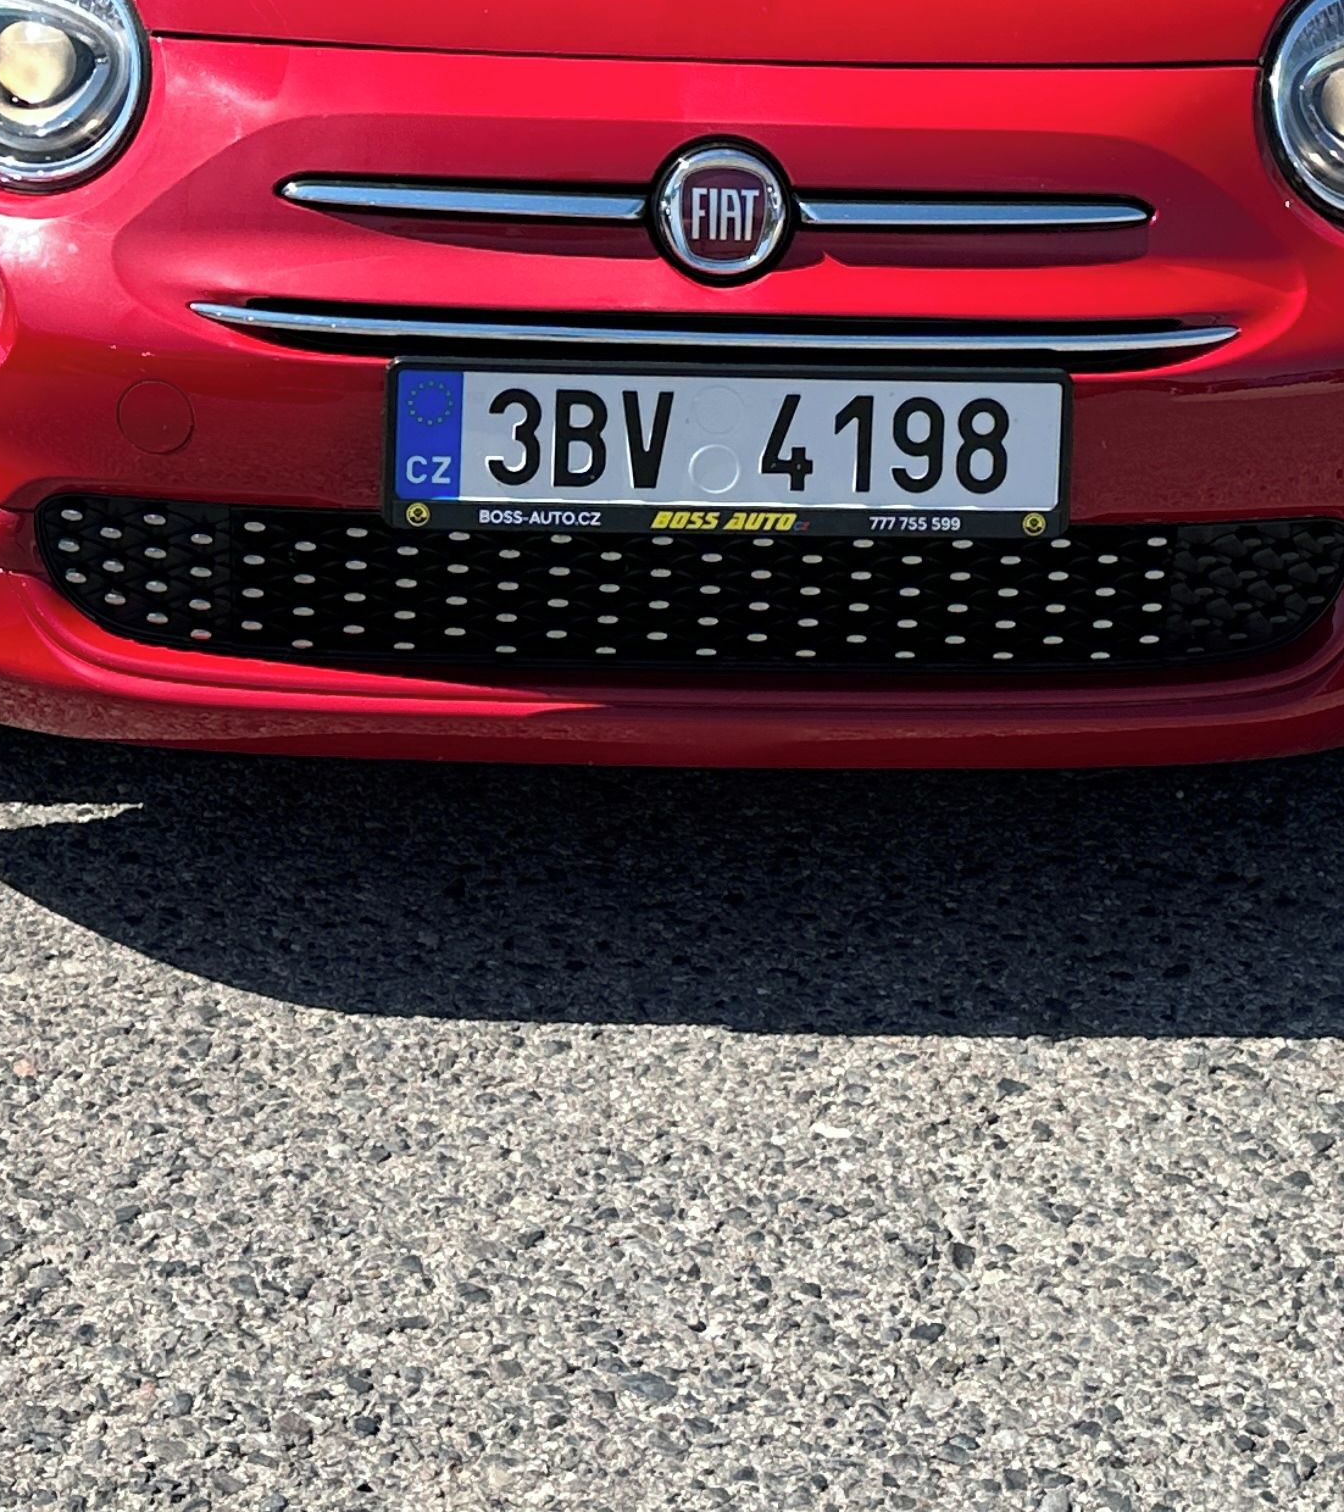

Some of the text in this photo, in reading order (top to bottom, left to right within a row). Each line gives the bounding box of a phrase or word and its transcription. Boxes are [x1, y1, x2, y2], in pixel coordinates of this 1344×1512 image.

[692, 187, 760, 241] FIAT
[485, 387, 1010, 495] 3BV 4198
[406, 455, 452, 485] CZ
[478, 509, 601, 527] BOSS-AUTO.CZ
[650, 511, 720, 530] BOSS
[722, 512, 797, 531] AUTO
[869, 517, 961, 531] 777 755 599
